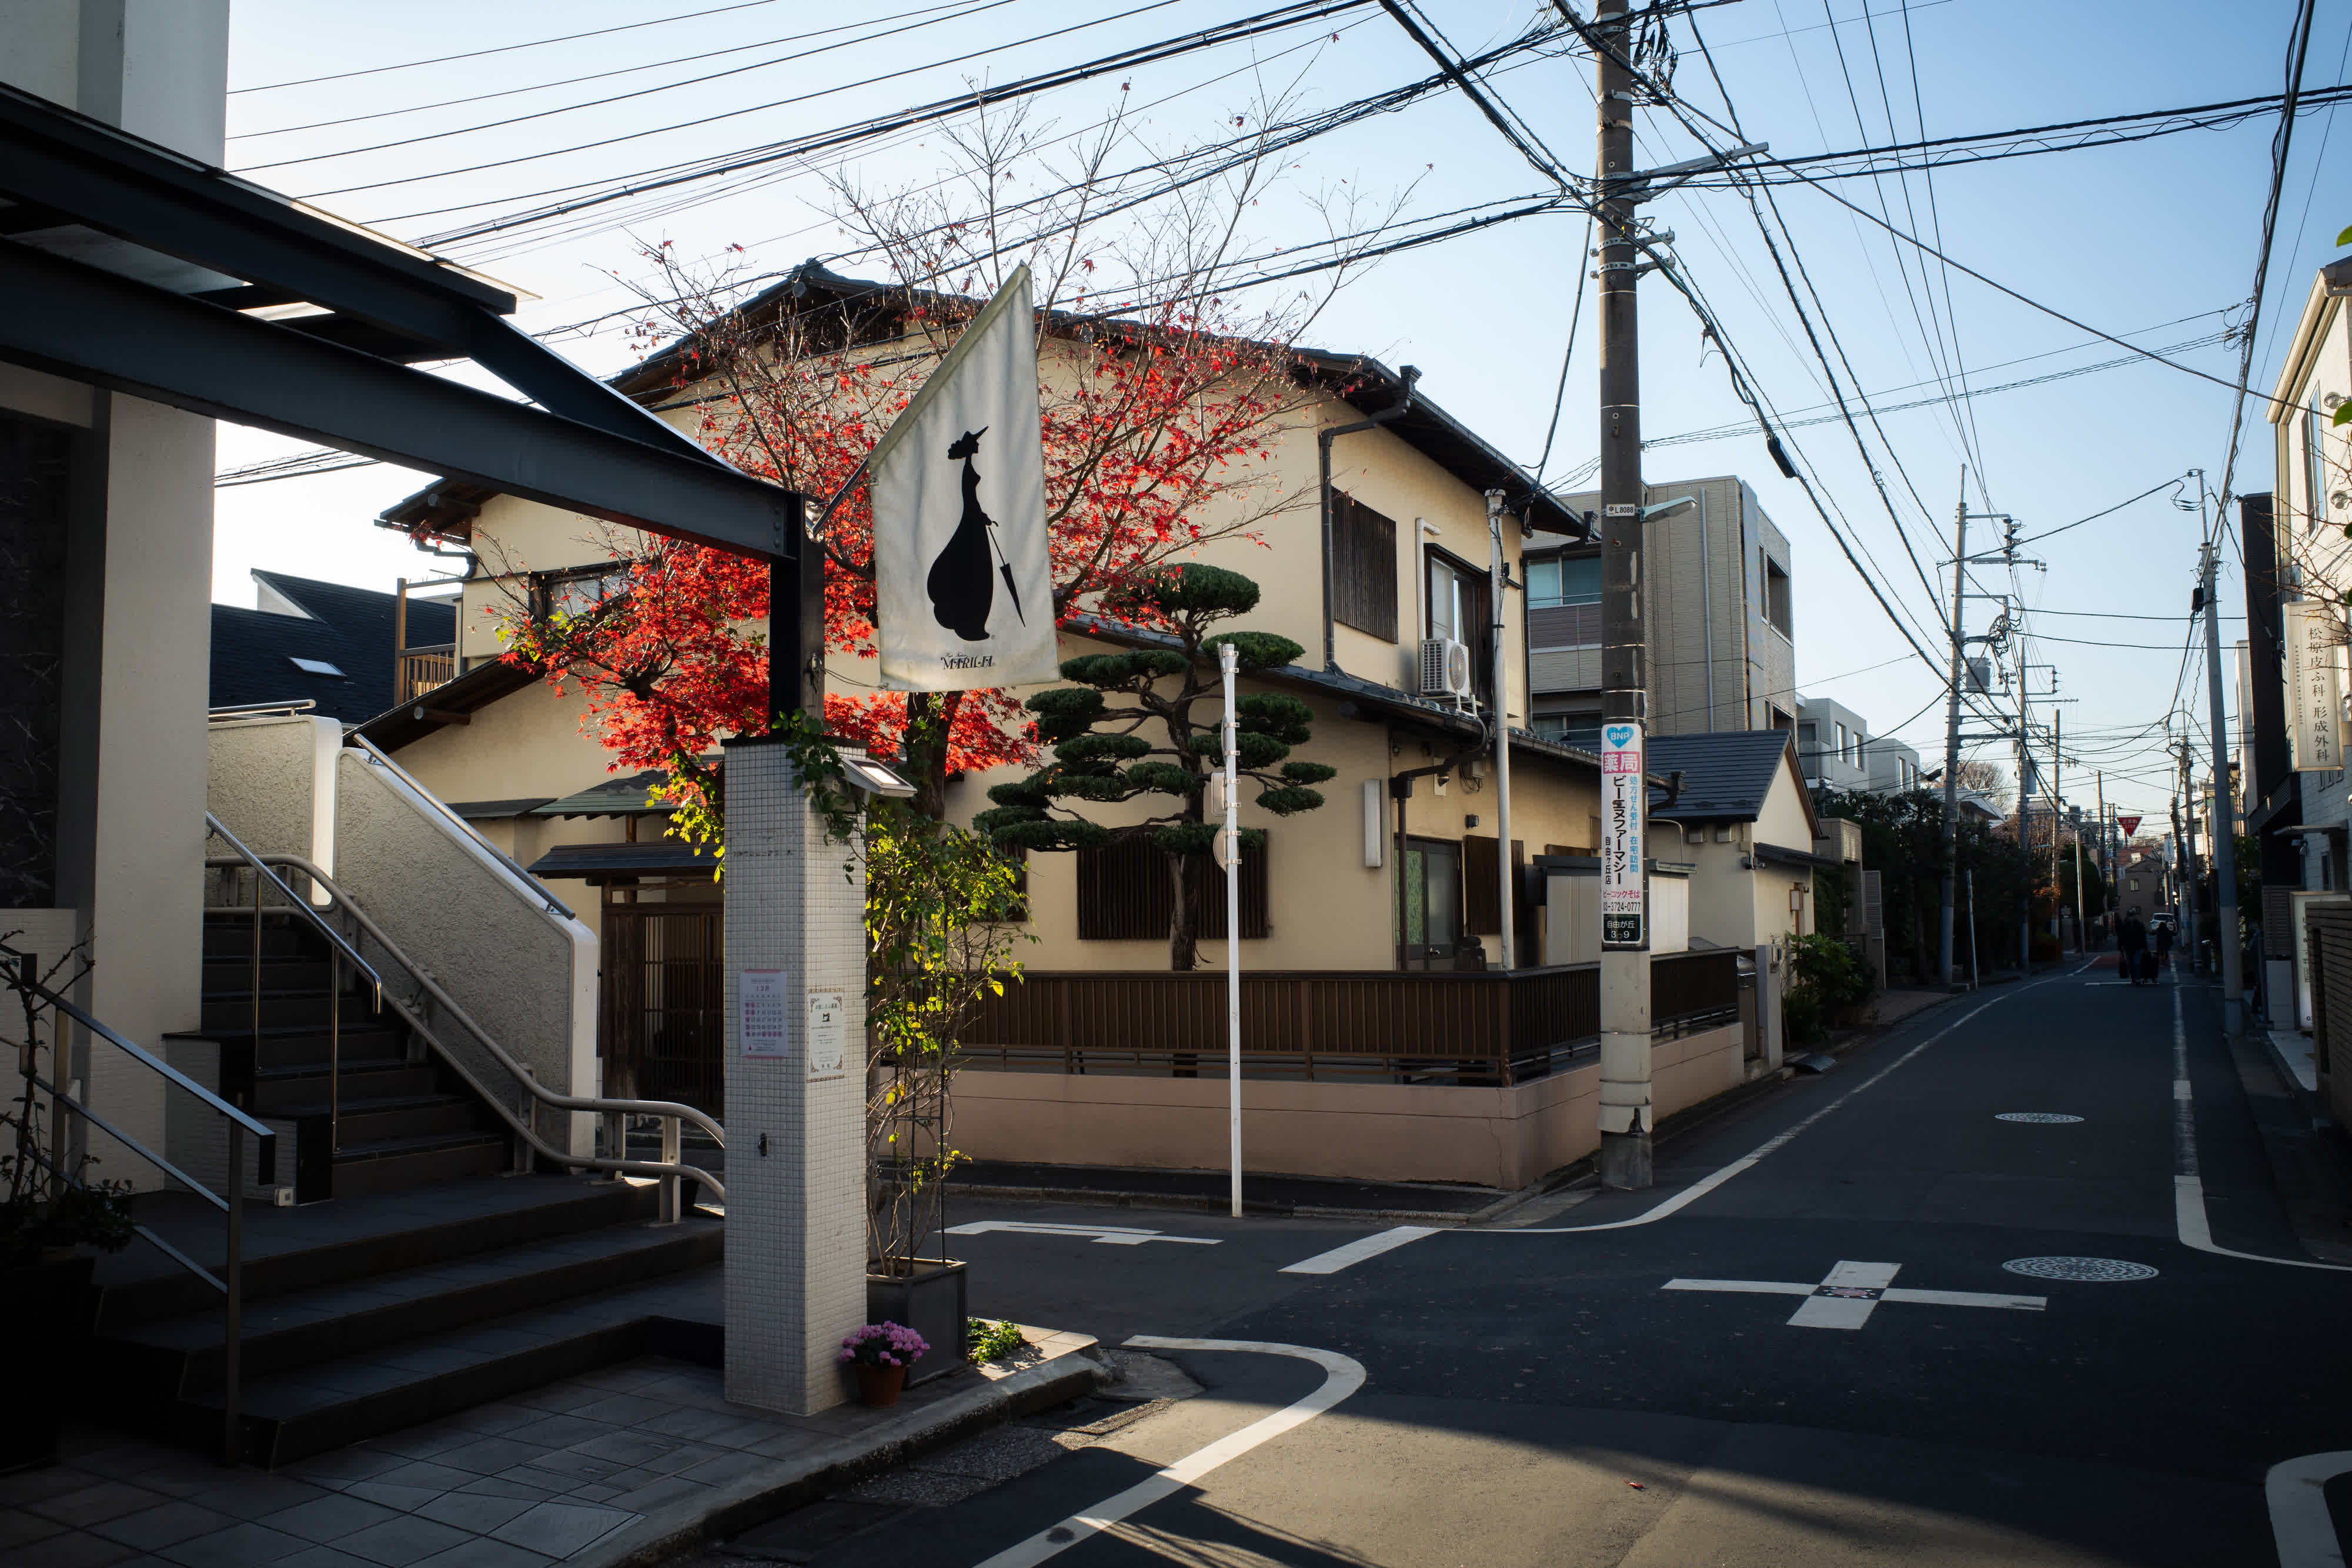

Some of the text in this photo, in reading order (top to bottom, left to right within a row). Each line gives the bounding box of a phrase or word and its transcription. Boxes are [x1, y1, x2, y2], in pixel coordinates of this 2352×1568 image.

[2309, 627, 2330, 763] 松原皮ふ科・形成外科
[1604, 754, 1638, 772] 薬局
[1630, 837, 1638, 873] 在宅訪問
[1603, 902, 1641, 912] 03-3724-0777
